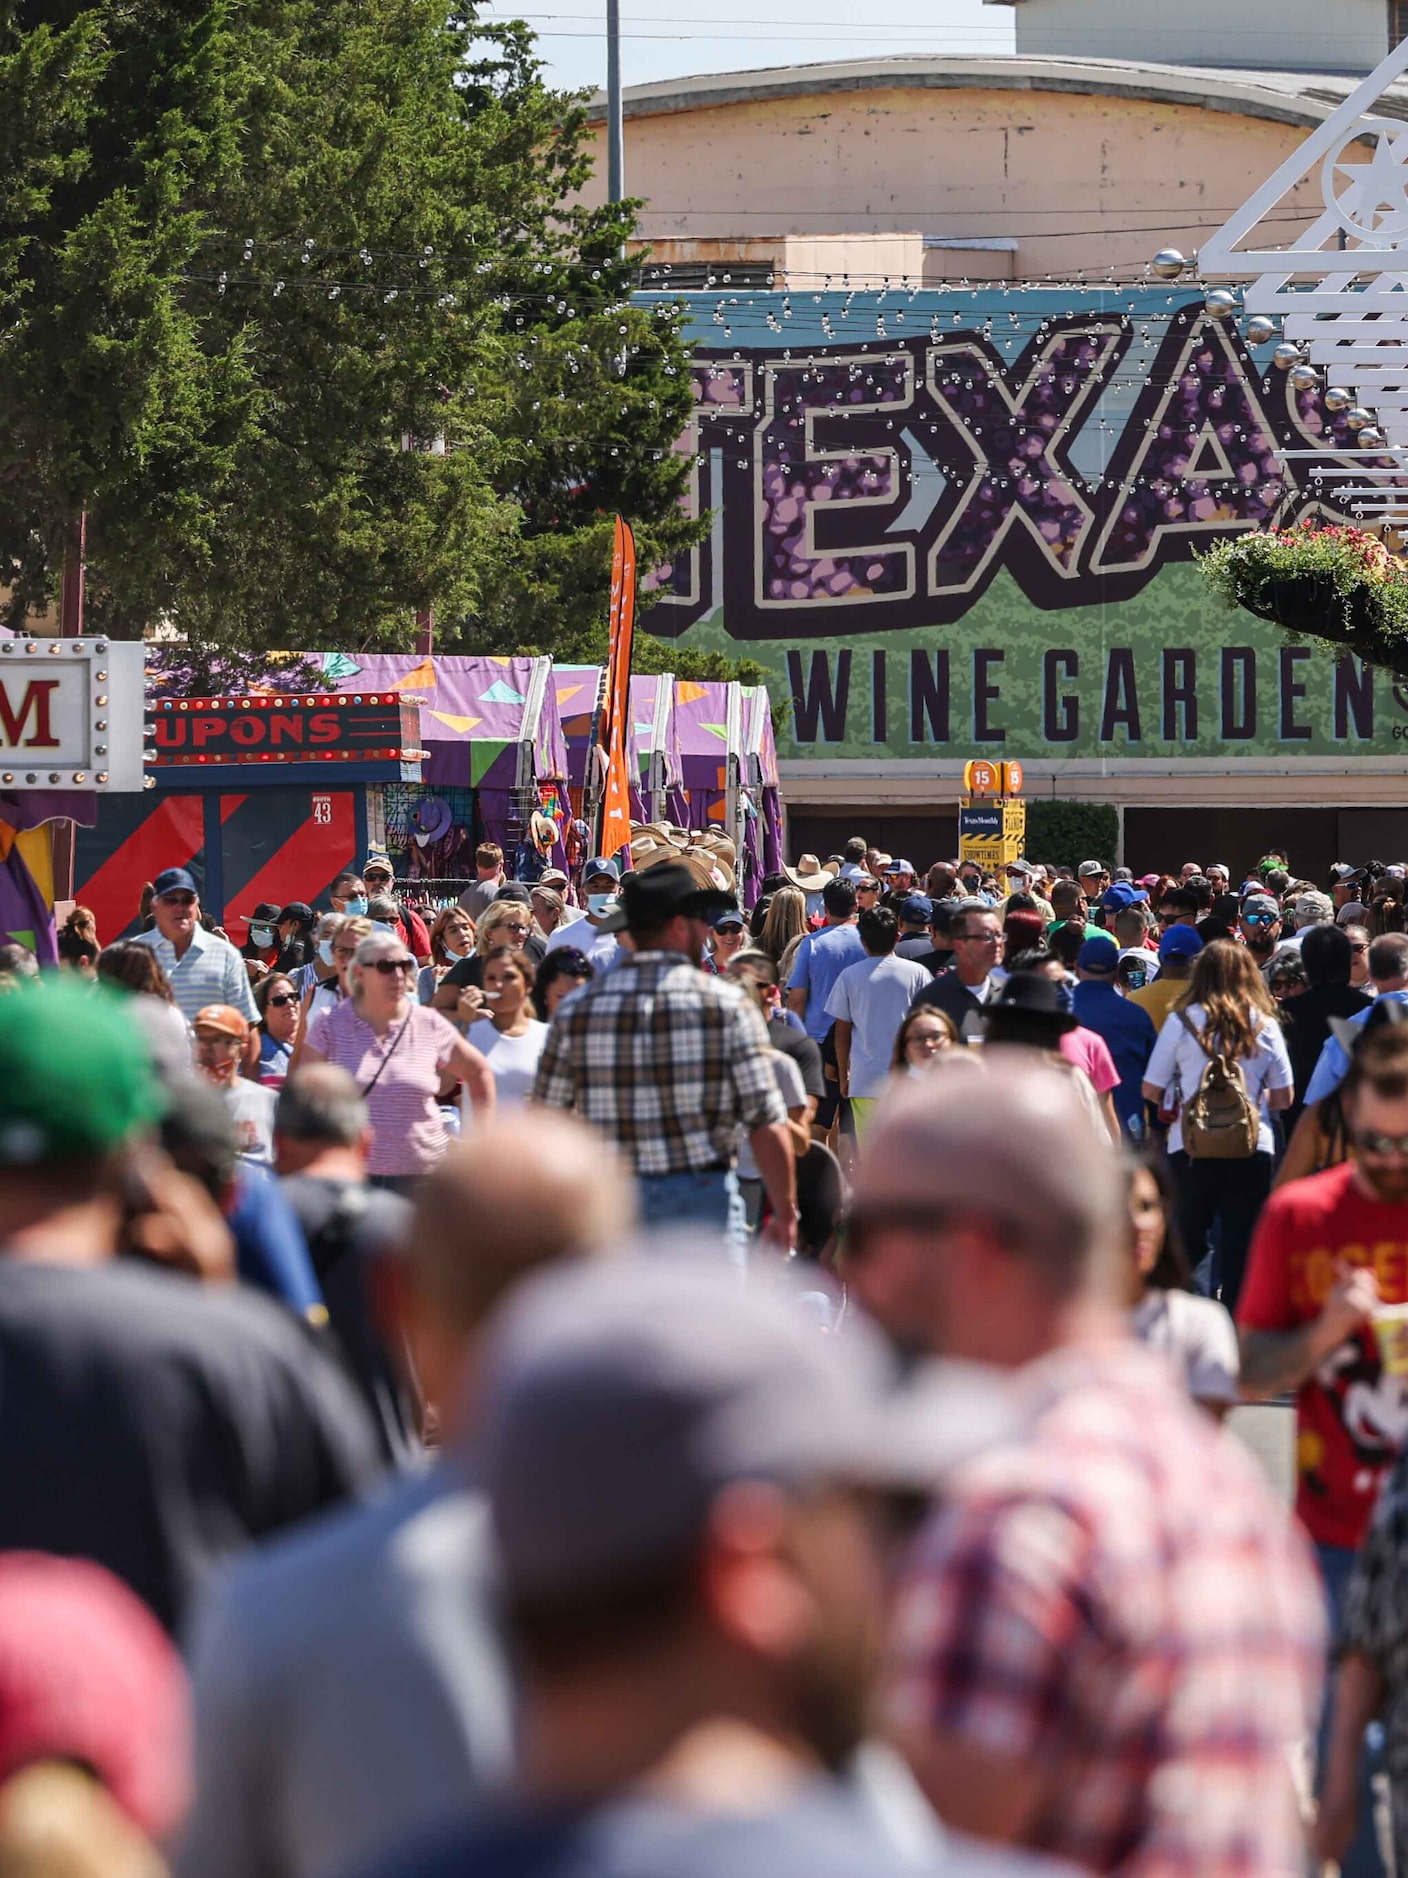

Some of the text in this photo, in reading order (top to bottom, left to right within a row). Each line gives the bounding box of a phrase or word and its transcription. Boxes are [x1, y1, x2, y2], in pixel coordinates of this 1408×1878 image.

[786, 647, 1374, 744] WINE GARDEN
[975, 771, 990, 785] 15
[314, 802, 331, 823] 43
